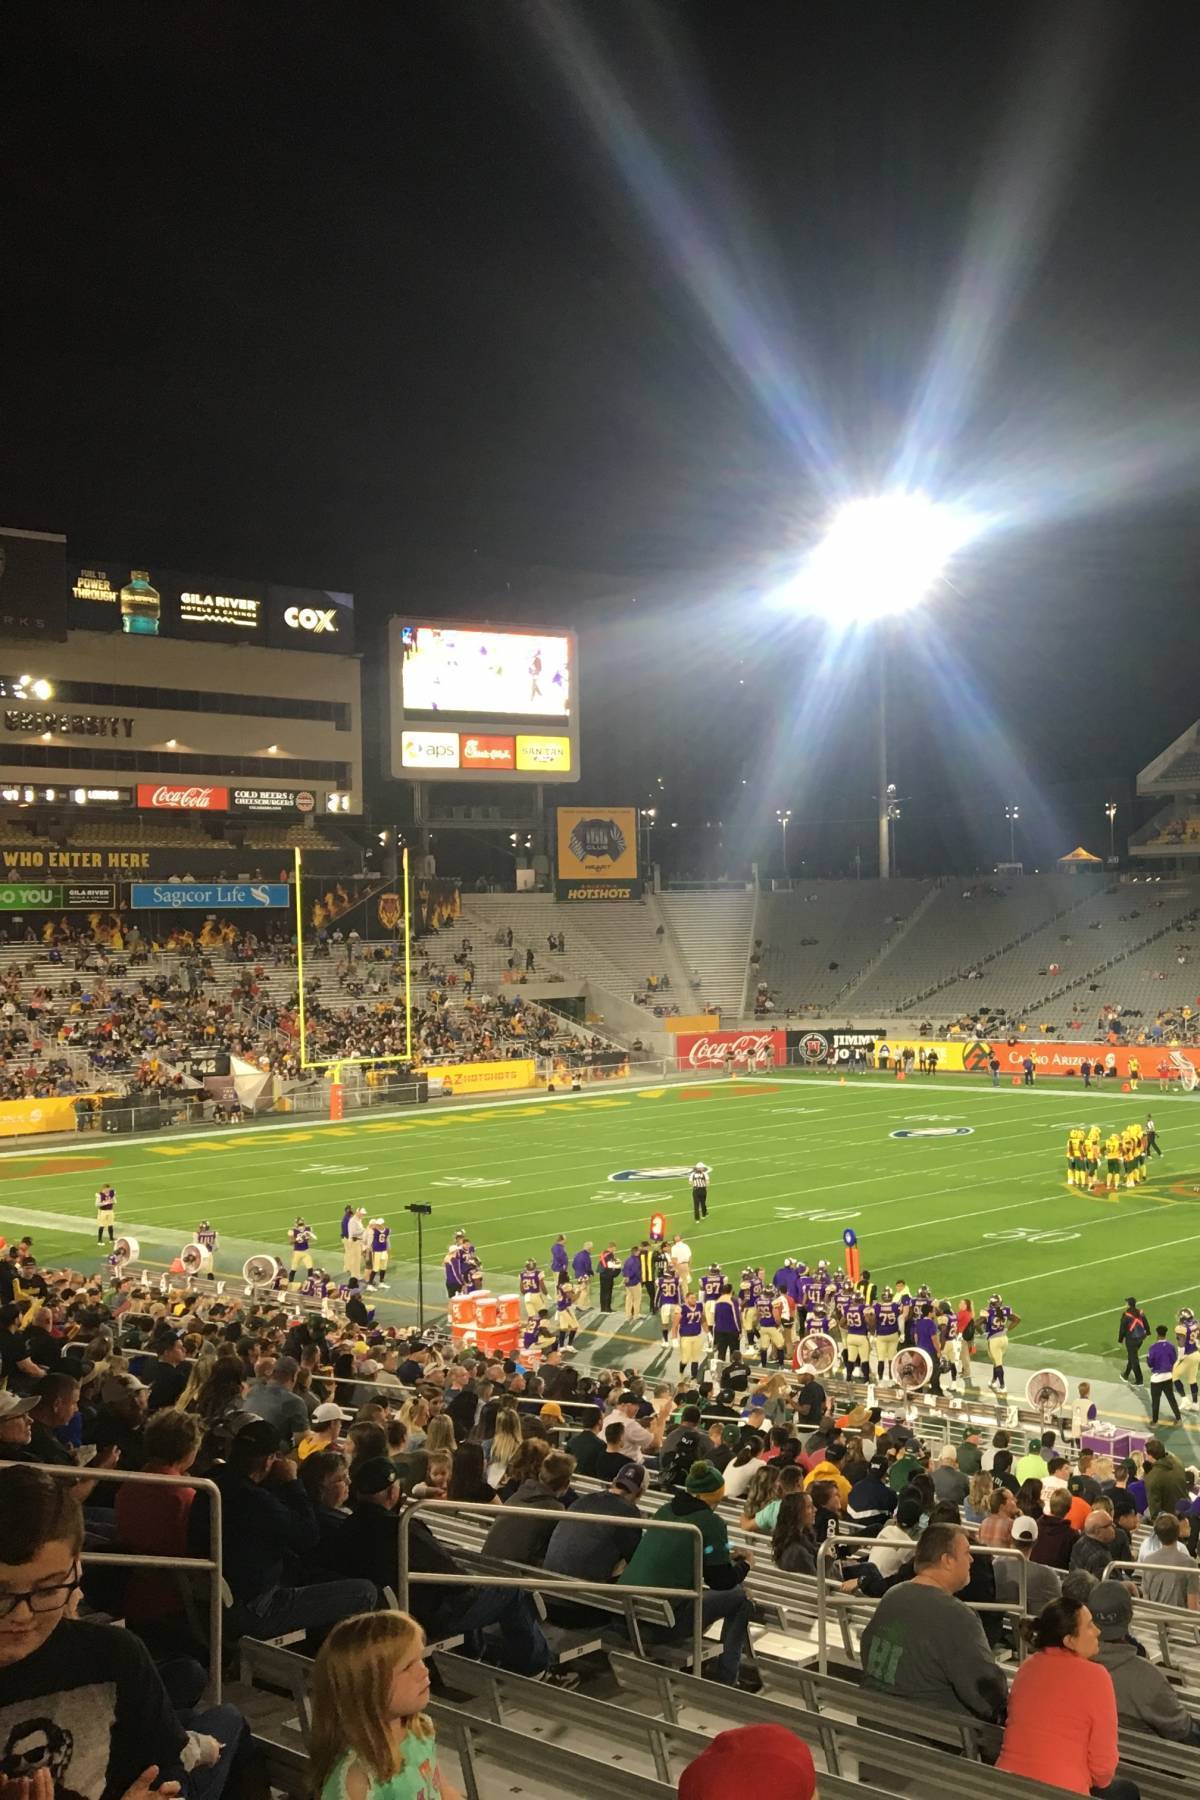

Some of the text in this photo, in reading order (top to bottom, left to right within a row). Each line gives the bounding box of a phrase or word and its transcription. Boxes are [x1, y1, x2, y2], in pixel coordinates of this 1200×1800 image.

[77, 577, 110, 590] POWER
[72, 587, 117, 602] THROUGH
[181, 593, 257, 611] GILA RIVER
[181, 605, 211, 613] HOTELS
[223, 610, 257, 618] CASINOS
[284, 607, 337, 633] COX
[426, 744, 454, 758] aps
[152, 786, 213, 807] Coca-Cola
[260, 791, 287, 799] BEERS
[4, 851, 150, 868] WHO ENTER HERE
[20, 890, 53, 904] YOU
[153, 888, 246, 907] Sagicor Life
[568, 888, 631, 899] HOTSHOTS
[833, 1035, 879, 1048] JIMMY
[200, 1060, 216, 1073] 42
[442, 1074, 462, 1086] AZ
[686, 1312, 702, 1325] 77
